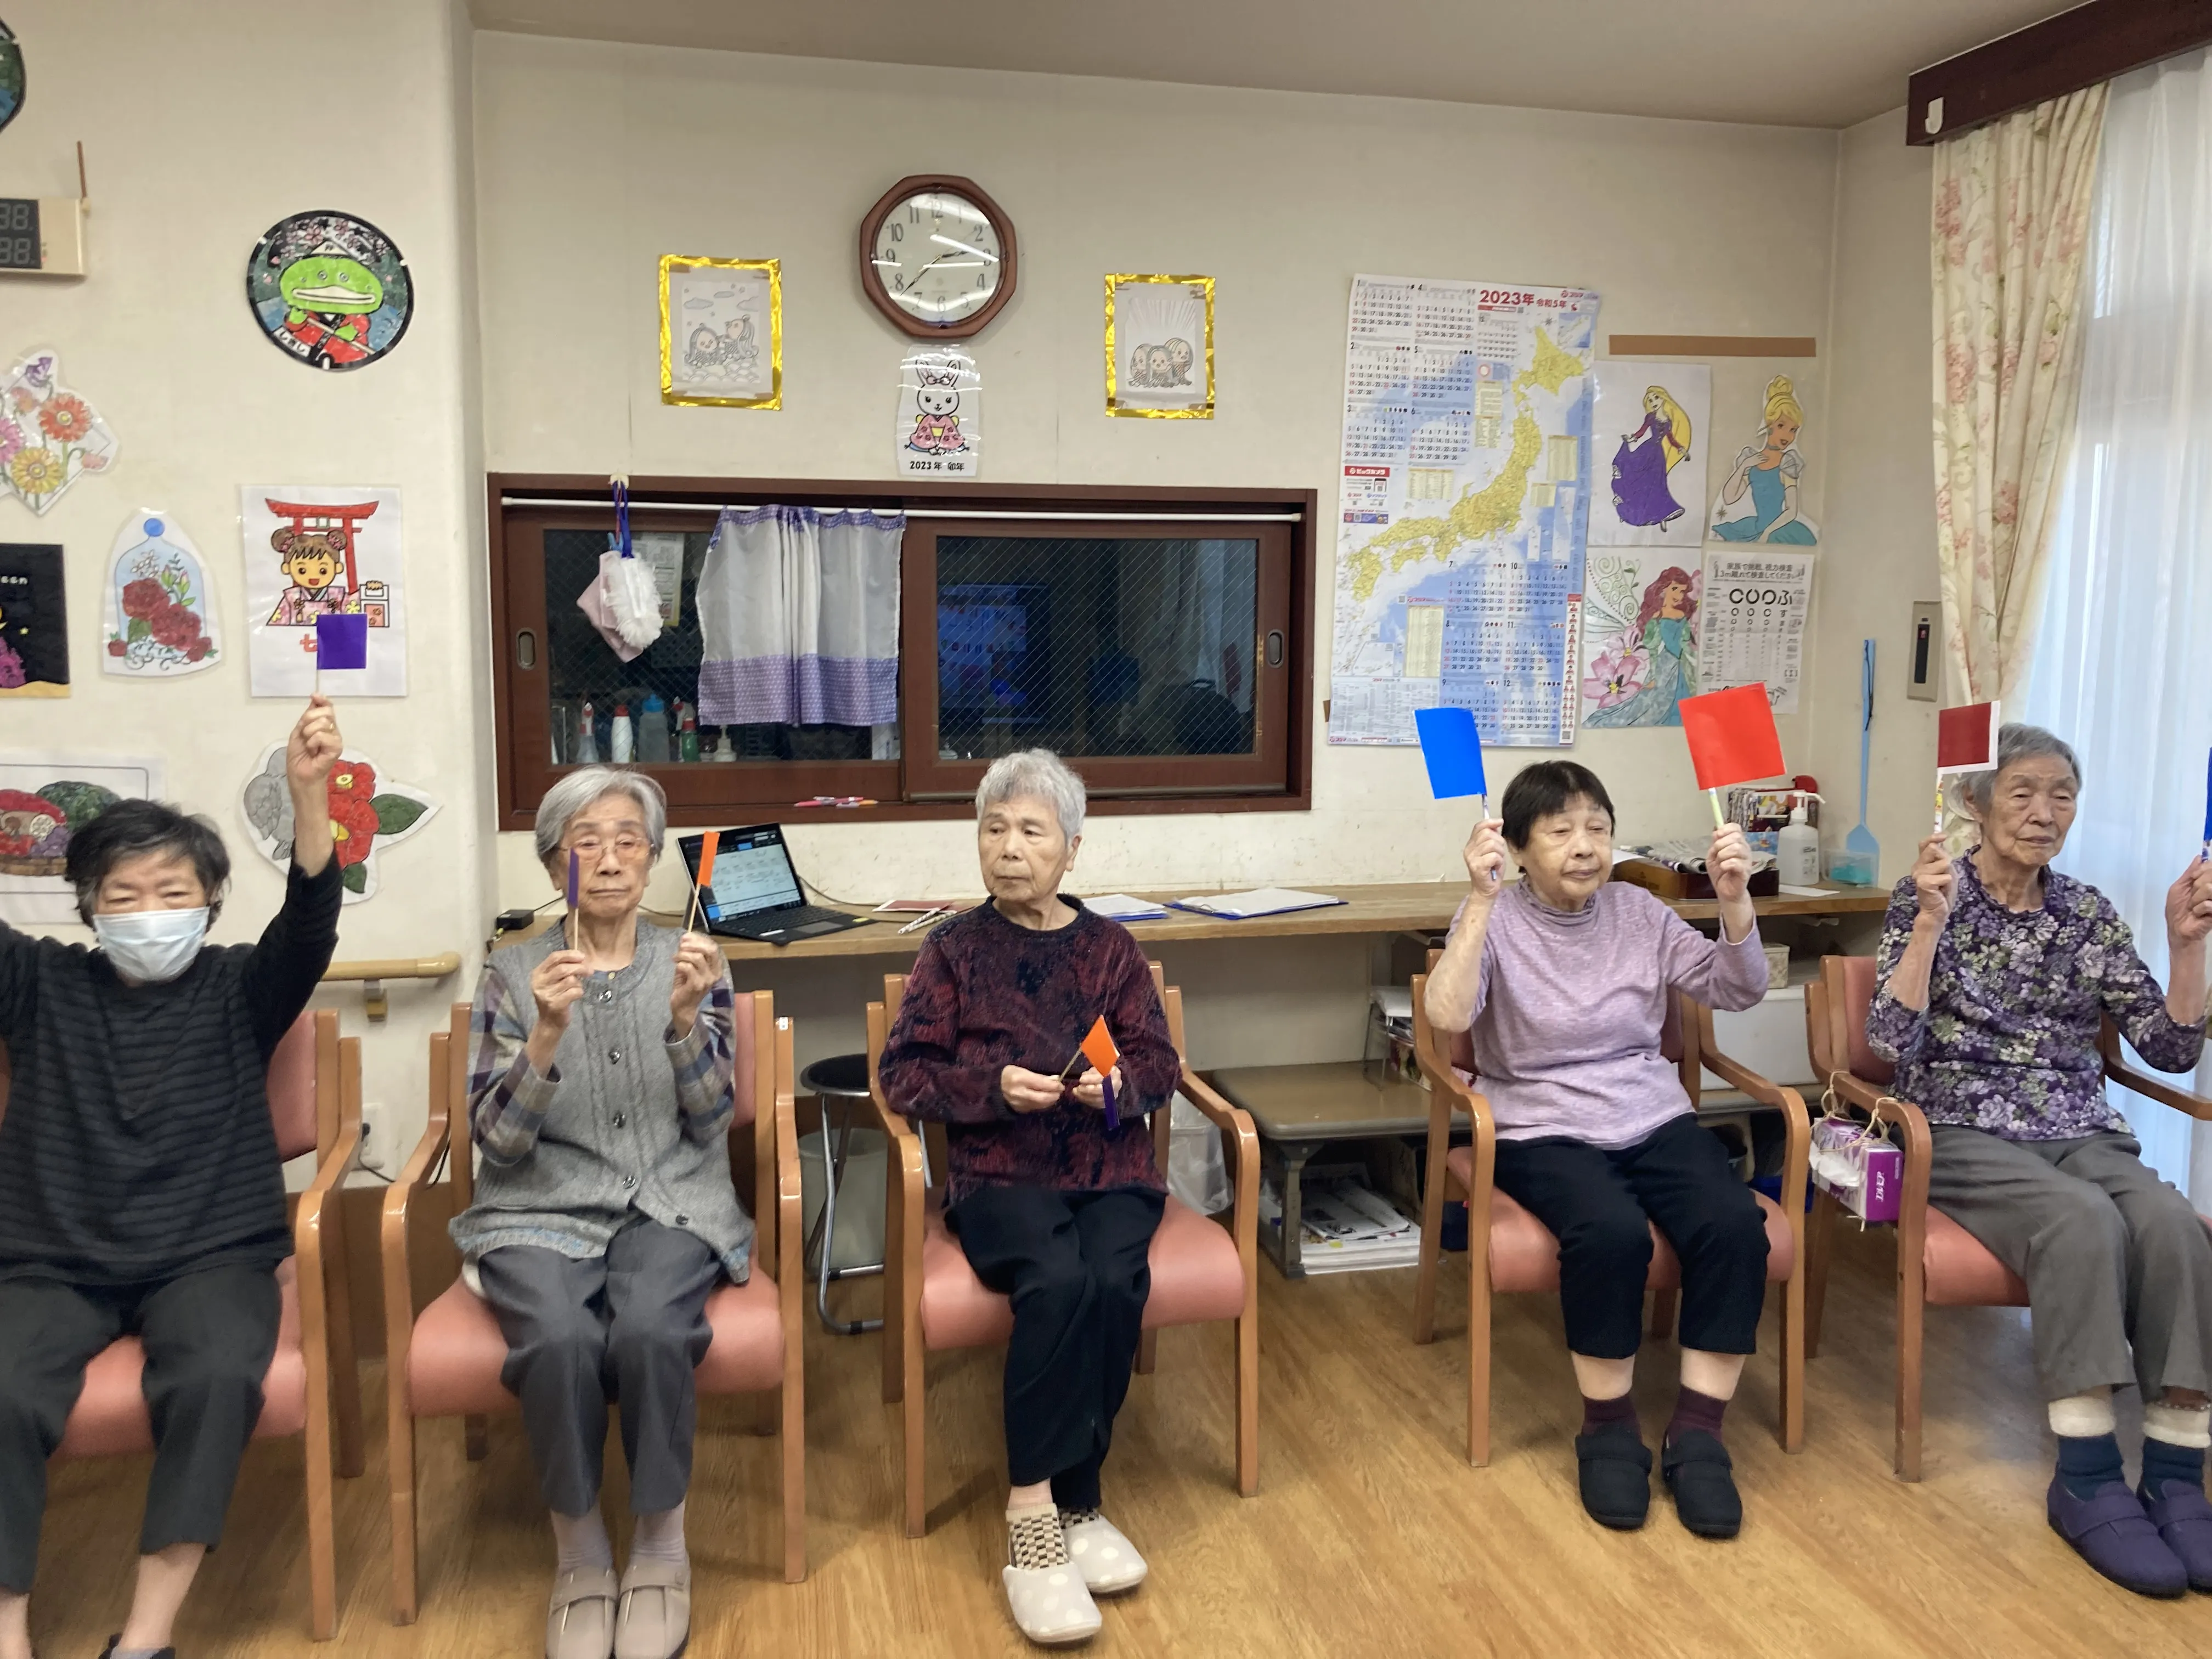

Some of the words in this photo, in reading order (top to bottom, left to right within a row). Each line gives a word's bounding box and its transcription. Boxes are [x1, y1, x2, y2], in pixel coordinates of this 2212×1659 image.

[910, 206, 919, 224] 11
[958, 206, 962, 224] 1
[890, 223, 904, 242] 10
[974, 225, 984, 242] 2
[885, 248, 895, 263] 9
[983, 248, 992, 267] 3
[895, 273, 904, 291] 8
[976, 273, 985, 291] 4
[914, 291, 922, 309] 7
[937, 296, 946, 312] 6
[960, 291, 969, 309] 5
[1480, 289, 1535, 306] 2023年
[1536, 298, 1567, 308] 令和5年
[910, 461, 943, 470] 2023年
[1777, 590, 1792, 605] ふ
